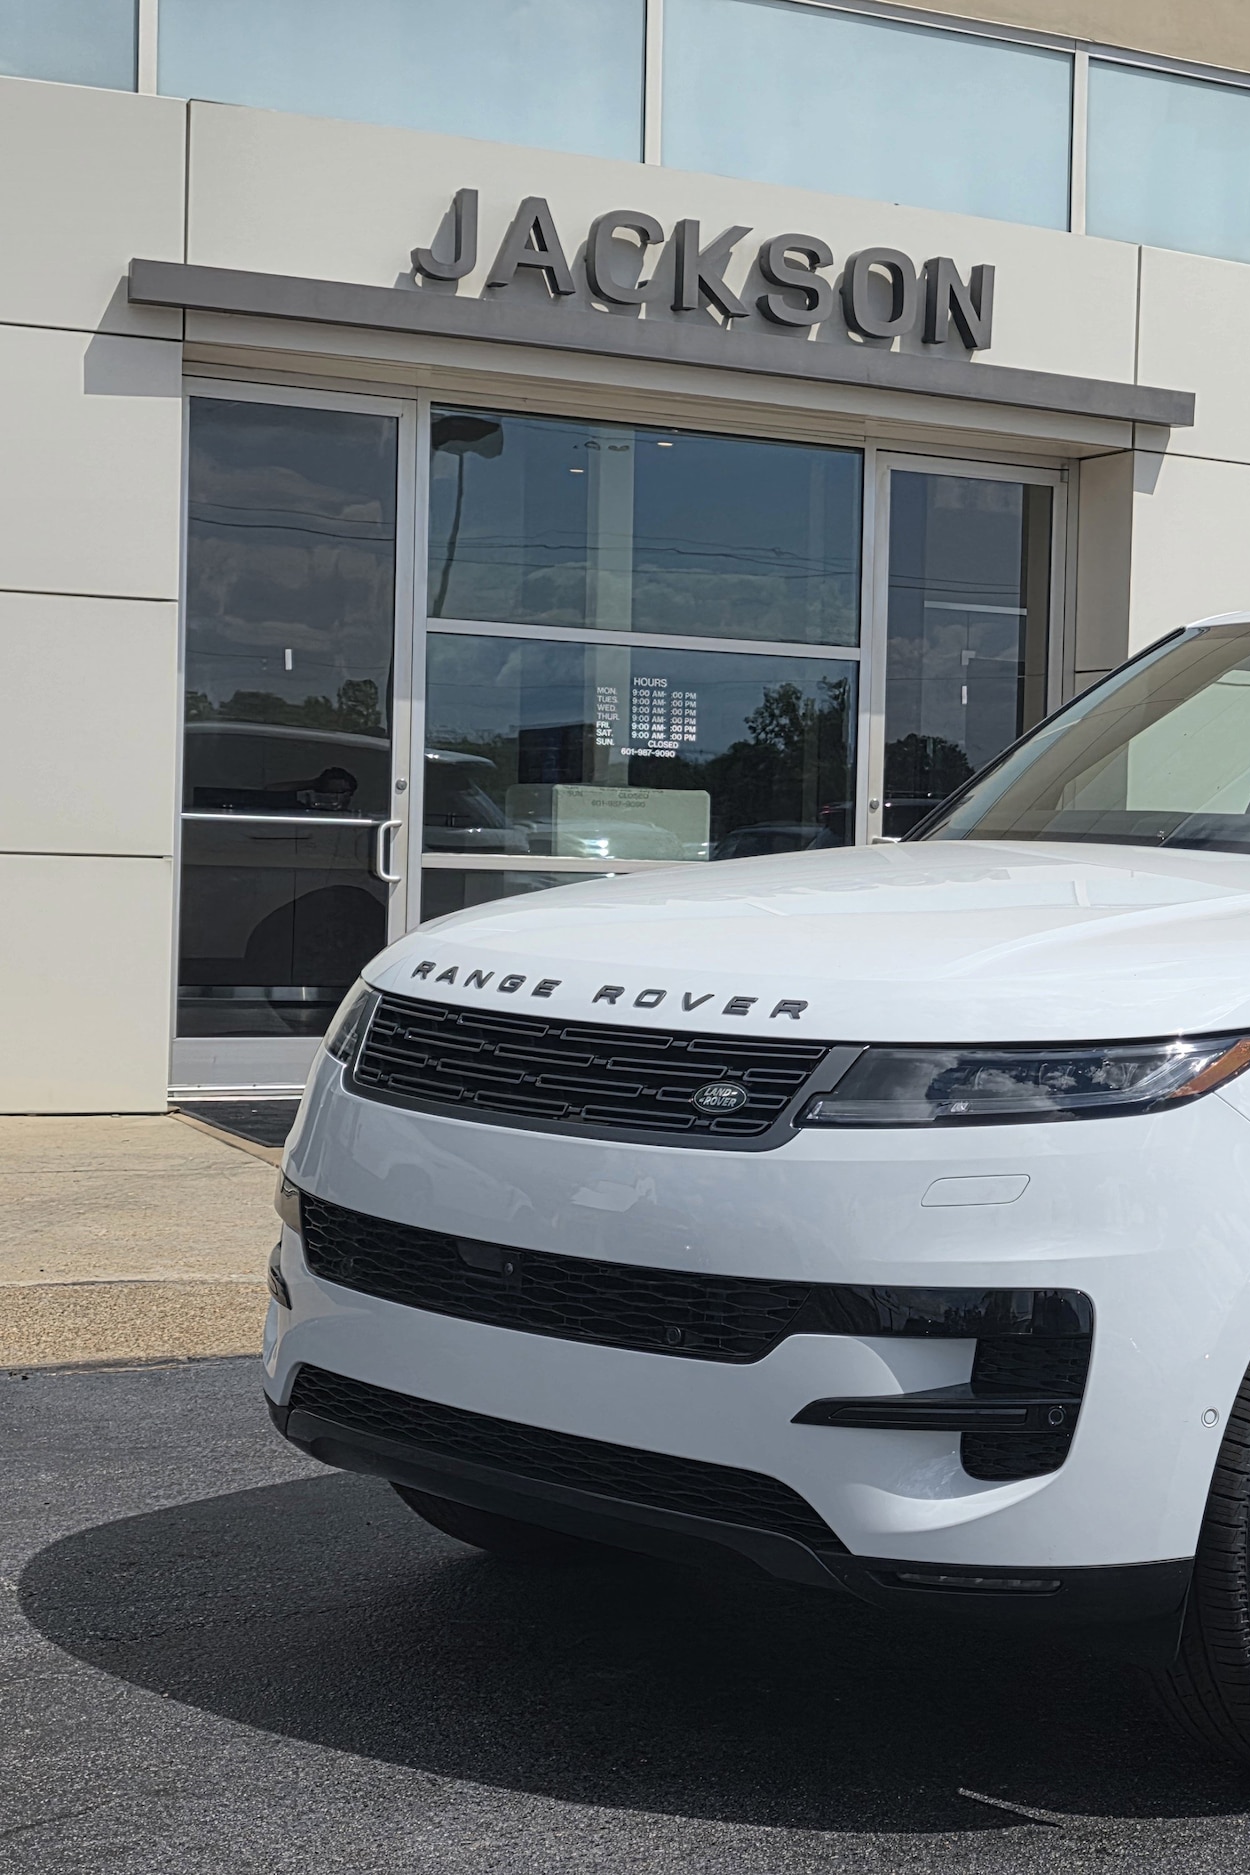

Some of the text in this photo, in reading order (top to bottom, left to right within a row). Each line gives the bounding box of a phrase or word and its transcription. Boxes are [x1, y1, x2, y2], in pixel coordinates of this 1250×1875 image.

[411, 188, 995, 351] JACKSON
[634, 677, 667, 687] HOURS
[632, 689, 650, 697] 9:00
[632, 731, 649, 739] 9:00
[648, 740, 678, 749] CLOSED
[621, 748, 675, 758] 601-987-9090
[410, 960, 810, 1020] RANGE ROVER
